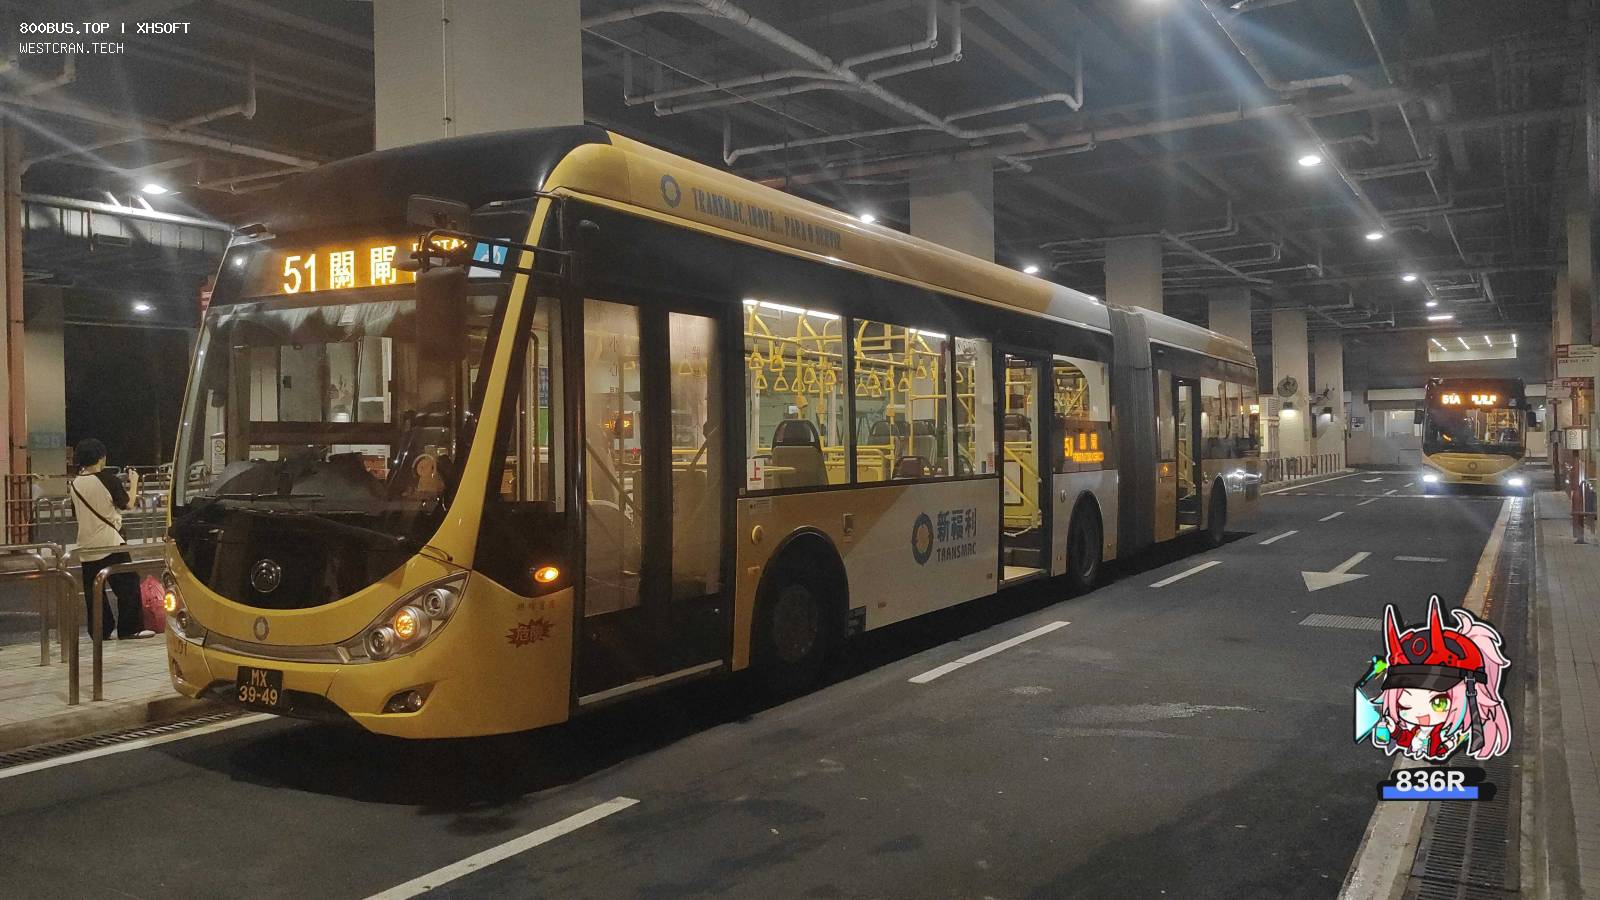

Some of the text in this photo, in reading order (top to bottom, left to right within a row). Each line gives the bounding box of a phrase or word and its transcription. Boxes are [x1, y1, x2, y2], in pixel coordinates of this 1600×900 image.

[283, 253, 317, 294] 51
[937, 507, 977, 542] 新福利
[936, 542, 977, 562] TRANSMAC
[251, 669, 268, 687] MX
[239, 685, 278, 705] 39-49
